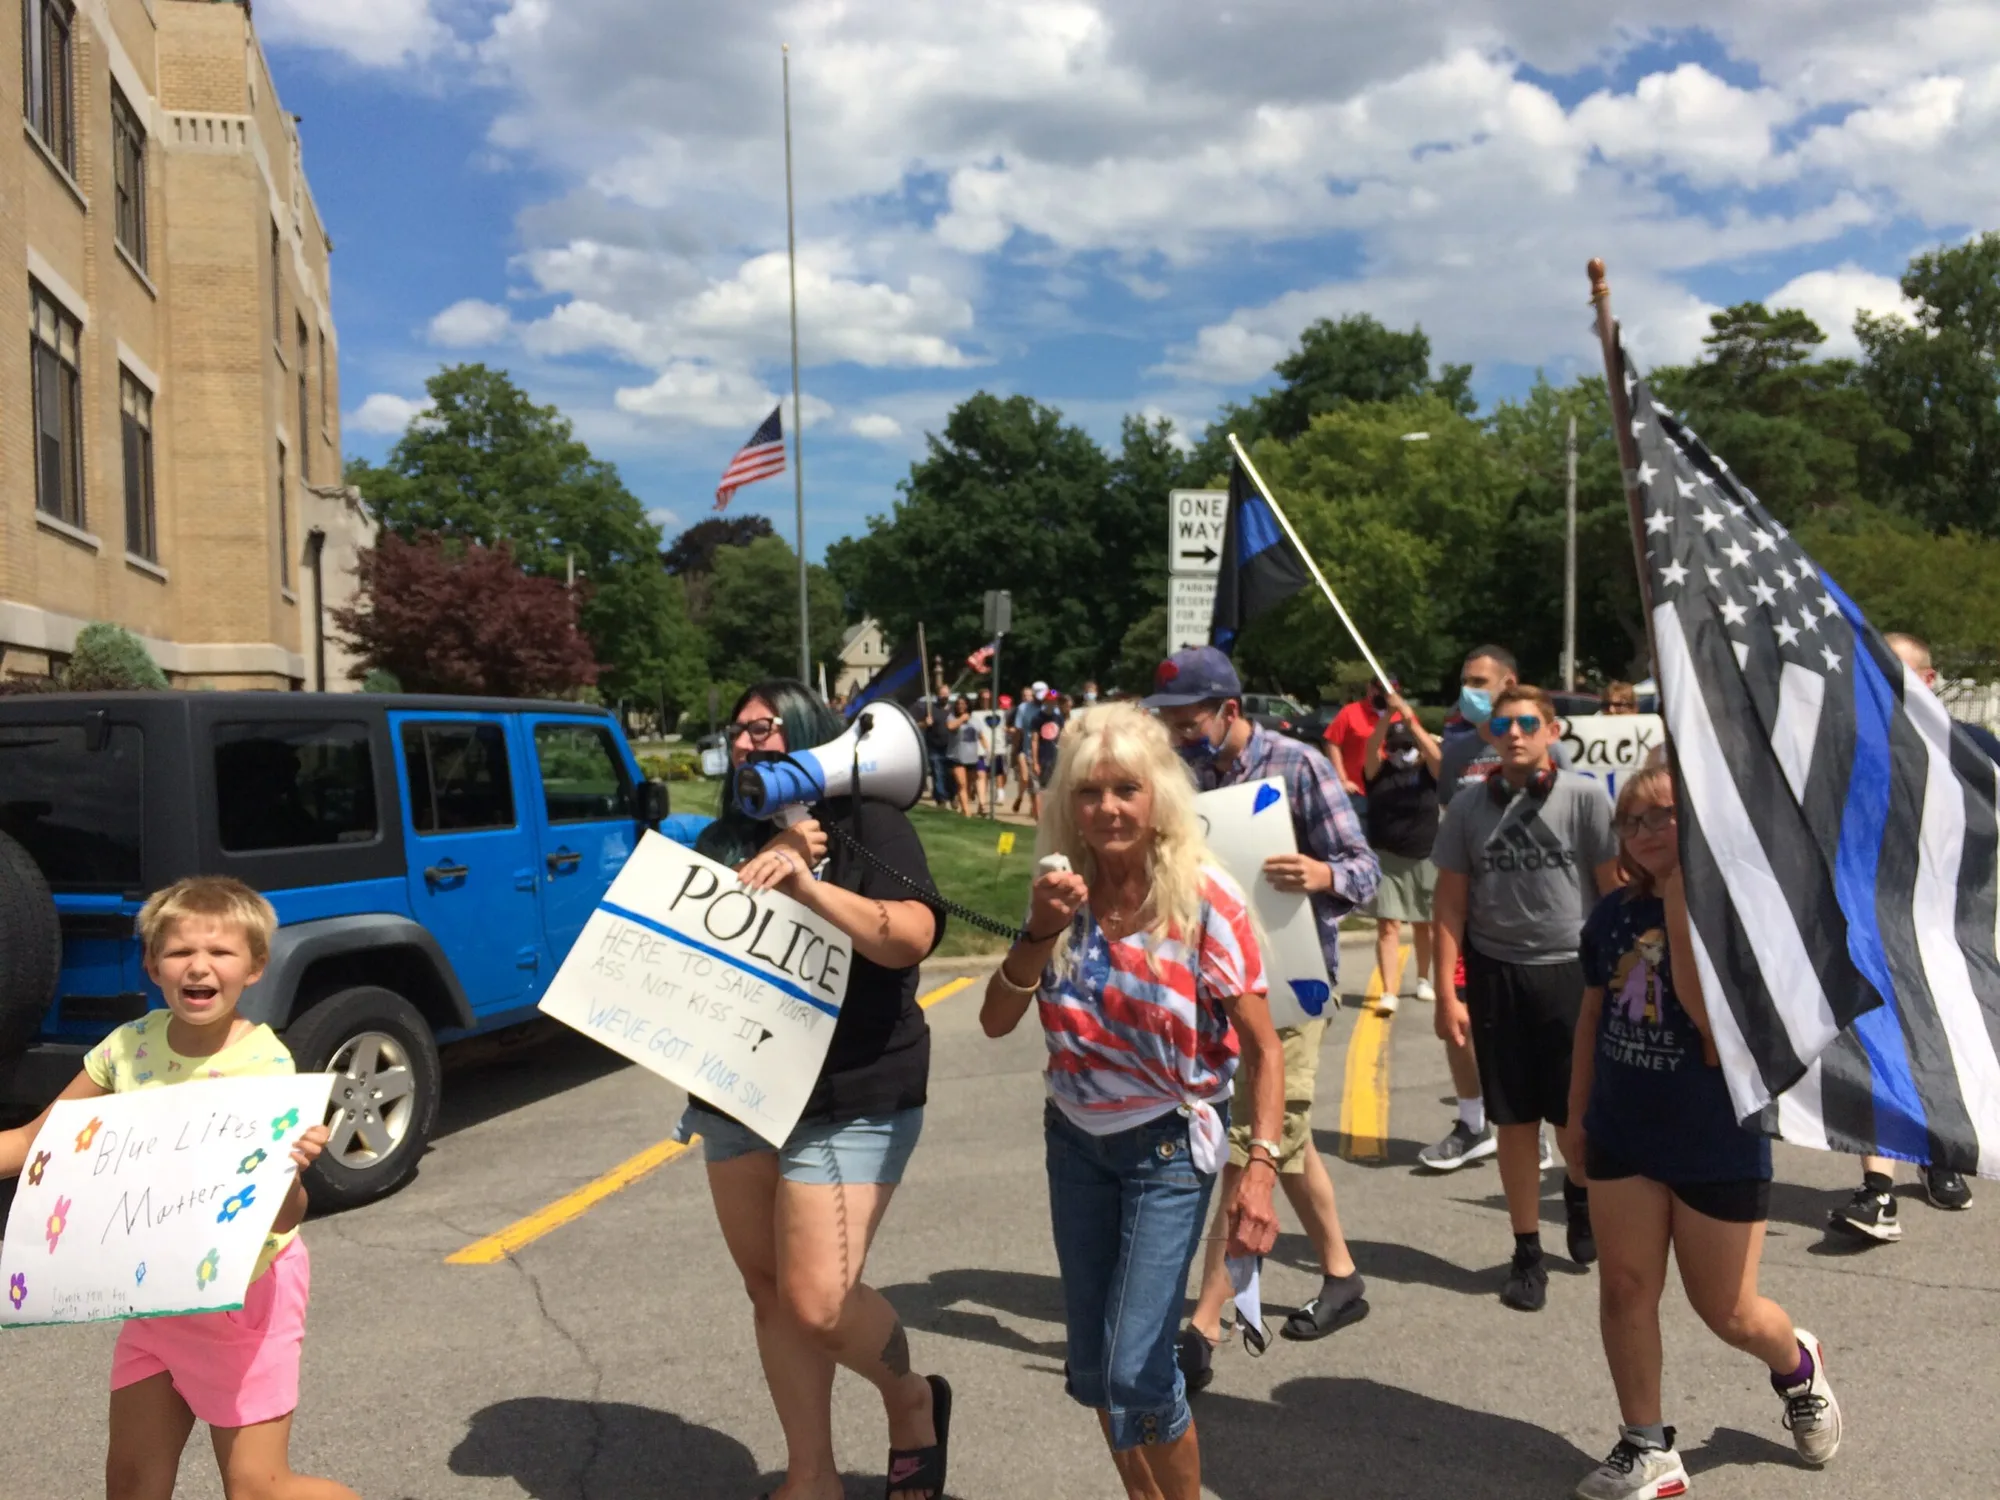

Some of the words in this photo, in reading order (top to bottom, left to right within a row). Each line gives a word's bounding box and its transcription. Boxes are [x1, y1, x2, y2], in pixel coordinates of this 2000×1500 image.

[1178, 521, 1224, 539] WAY
[1179, 498, 1223, 517] ONE
[1175, 595, 1214, 606] RESERV
[1481, 849, 1574, 873] adidas
[668, 864, 848, 995] POLICE
[600, 920, 667, 966] HERE
[678, 950, 713, 978] TO
[715, 969, 767, 1004] SAVE
[776, 993, 813, 1028] YOUR
[641, 972, 682, 999] NOT
[687, 991, 735, 1022] KISS
[648, 1026, 694, 1062] GOT
[692, 1050, 741, 1096] YOUR
[93, 1126, 159, 1177] Blue
[100, 1183, 226, 1246] Matter
